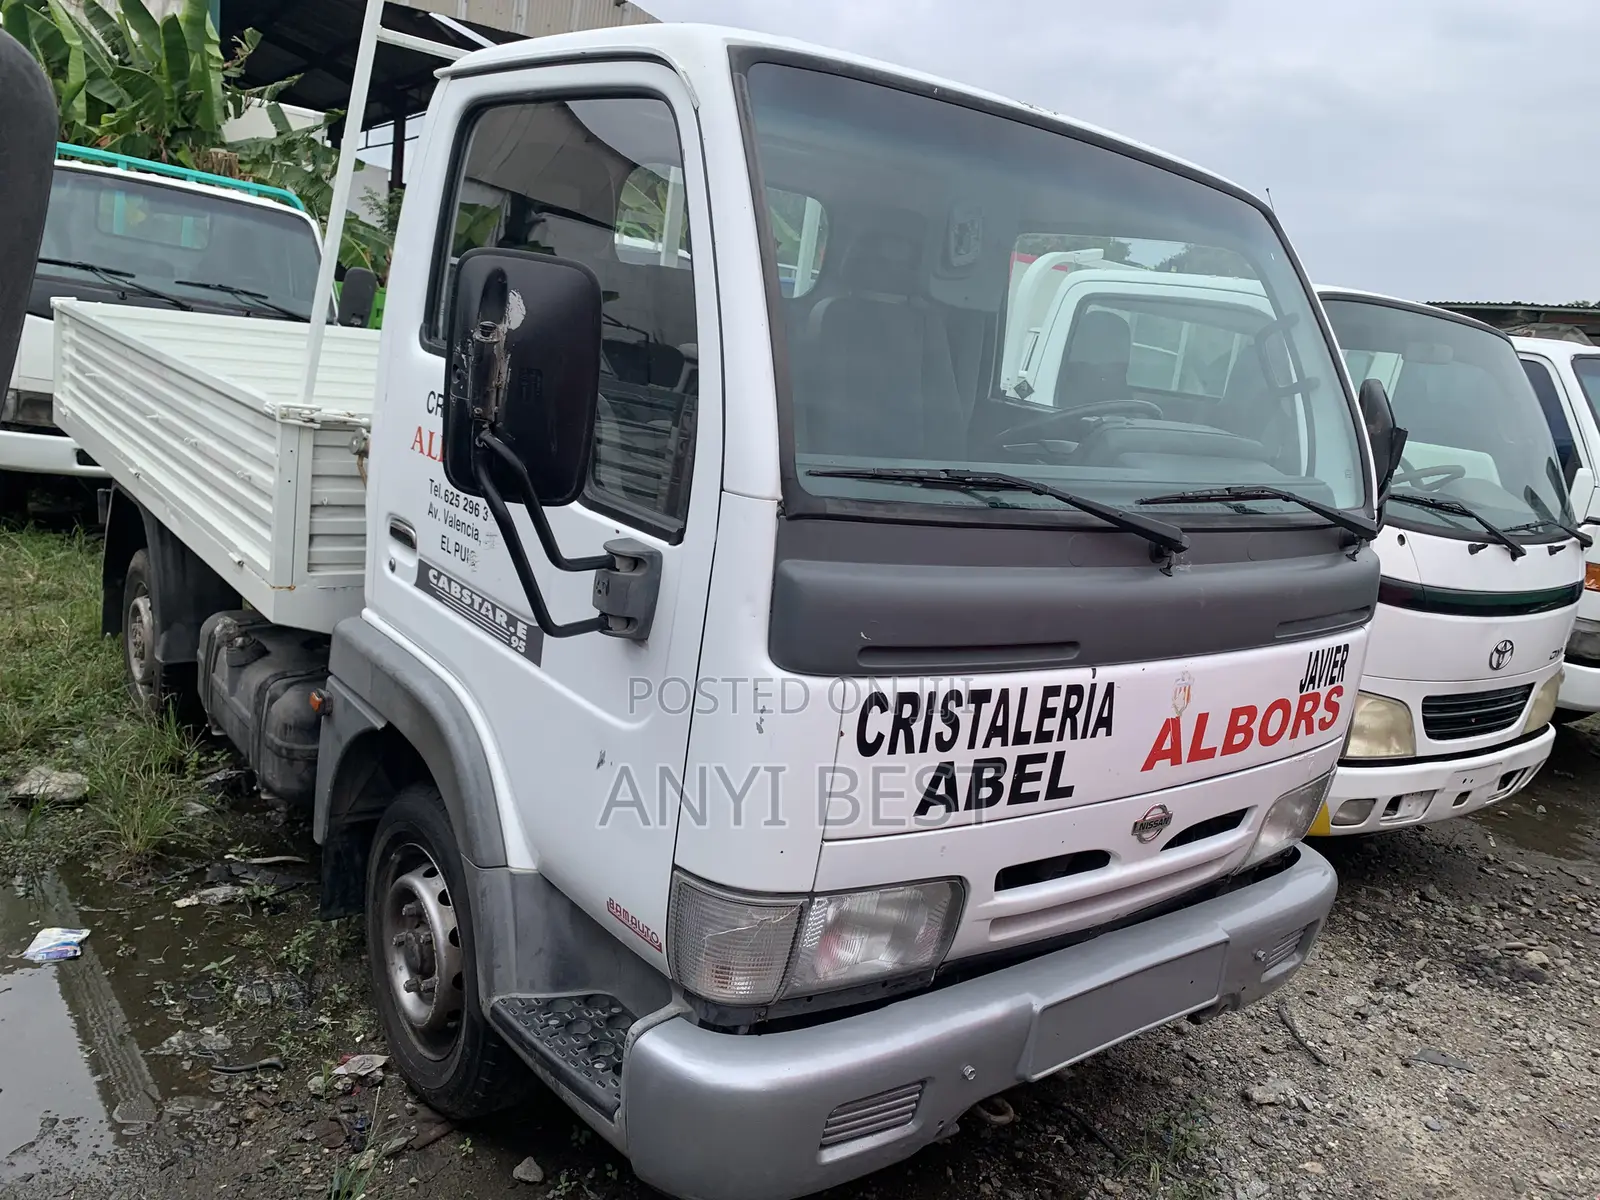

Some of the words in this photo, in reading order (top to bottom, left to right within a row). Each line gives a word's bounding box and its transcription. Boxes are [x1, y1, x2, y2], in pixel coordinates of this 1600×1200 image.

[426, 390, 444, 418] CR
[429, 478, 443, 499] Tel.
[444, 489, 460, 508] 625
[463, 496, 480, 517] 296
[427, 501, 441, 522] Av.
[443, 508, 482, 546] Valencia,
[441, 534, 451, 554] EL
[510, 636, 526, 653] 95
[1299, 643, 1350, 694] JAVIER
[1140, 685, 1344, 772] ALBORS
[913, 750, 1075, 817] ABEL
[1138, 816, 1171, 831] NISSAN
